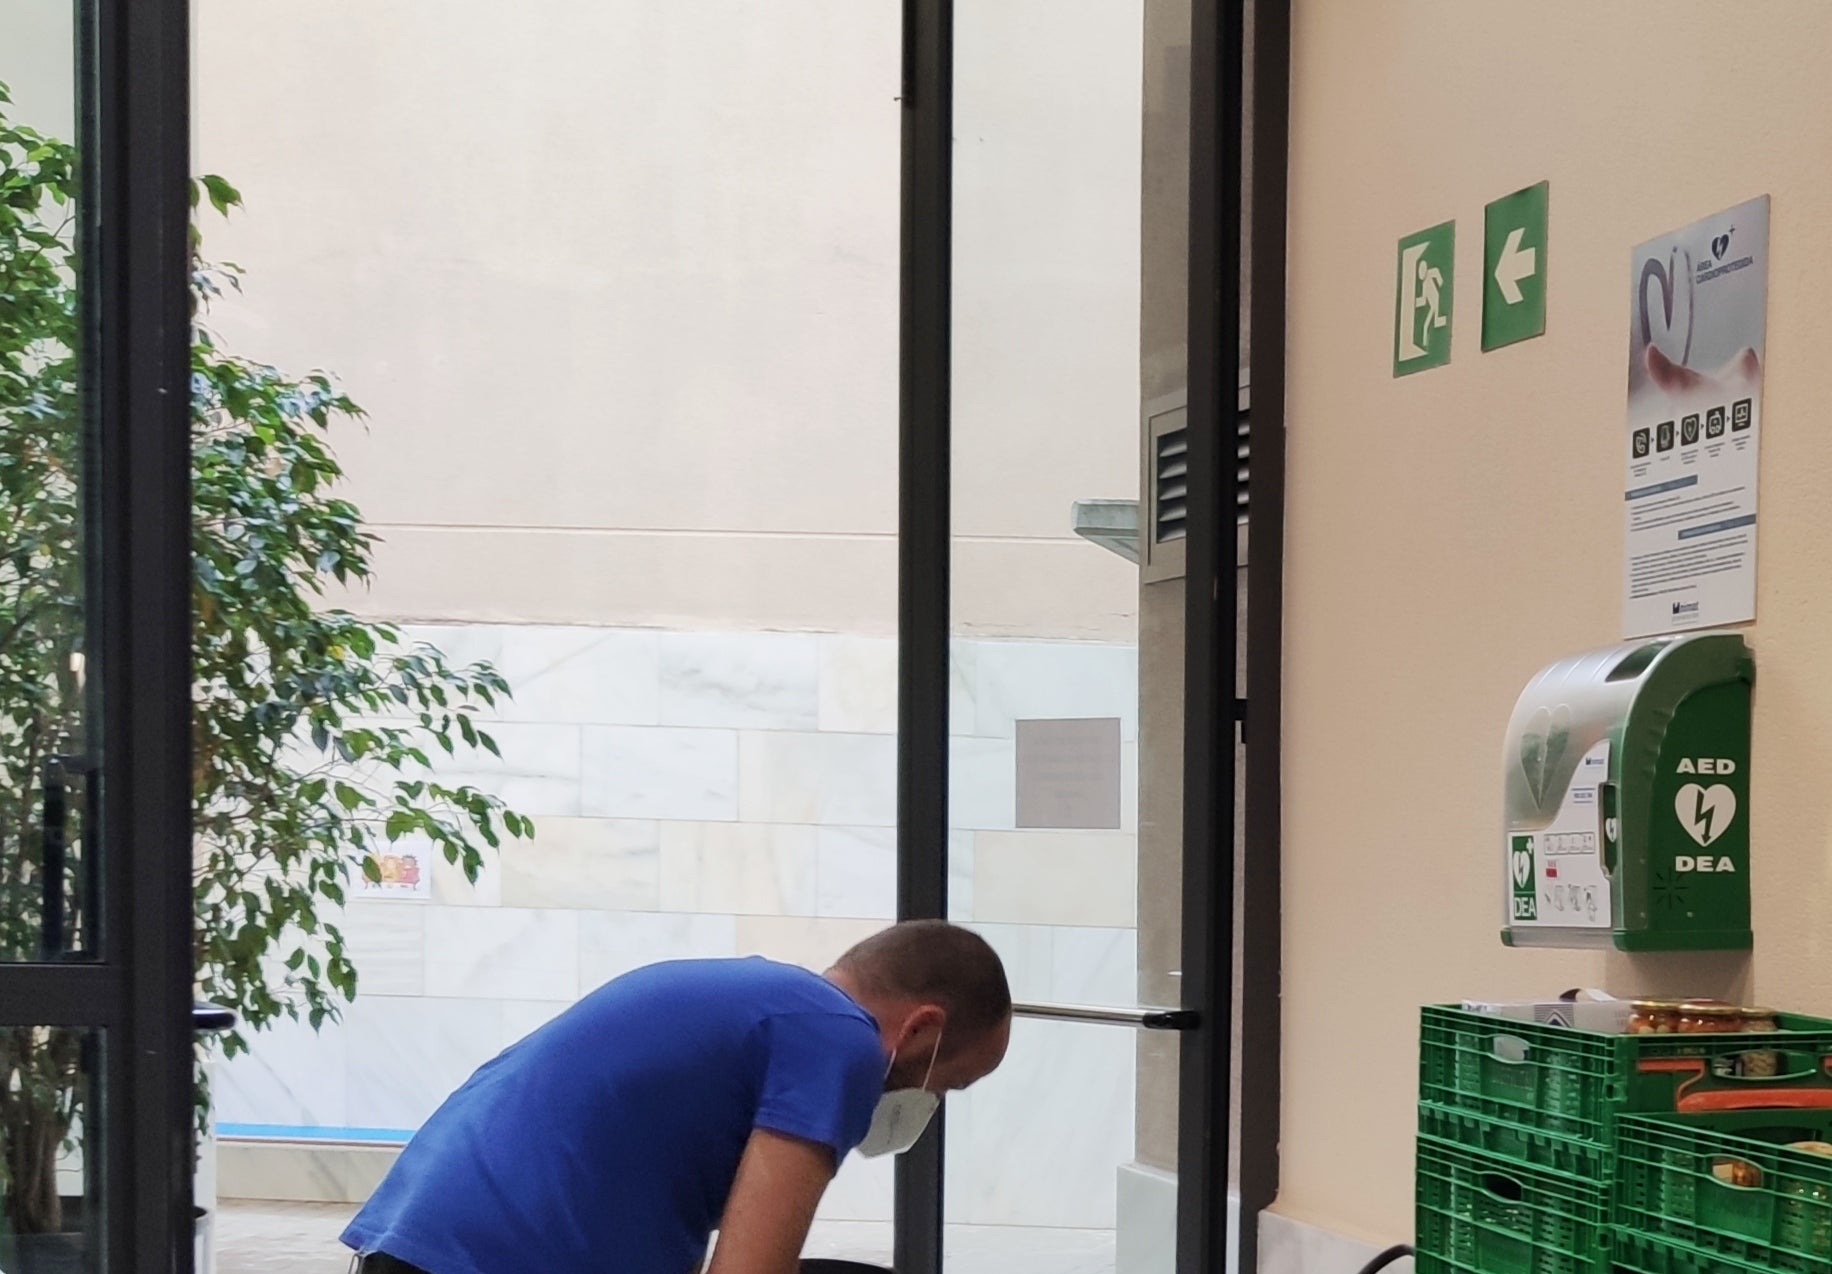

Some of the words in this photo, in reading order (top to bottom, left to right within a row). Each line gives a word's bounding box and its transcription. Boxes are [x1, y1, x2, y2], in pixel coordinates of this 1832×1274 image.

[1676, 757, 1736, 775] AED
[1675, 855, 1736, 872] DEA
[1514, 896, 1537, 918] DEA
